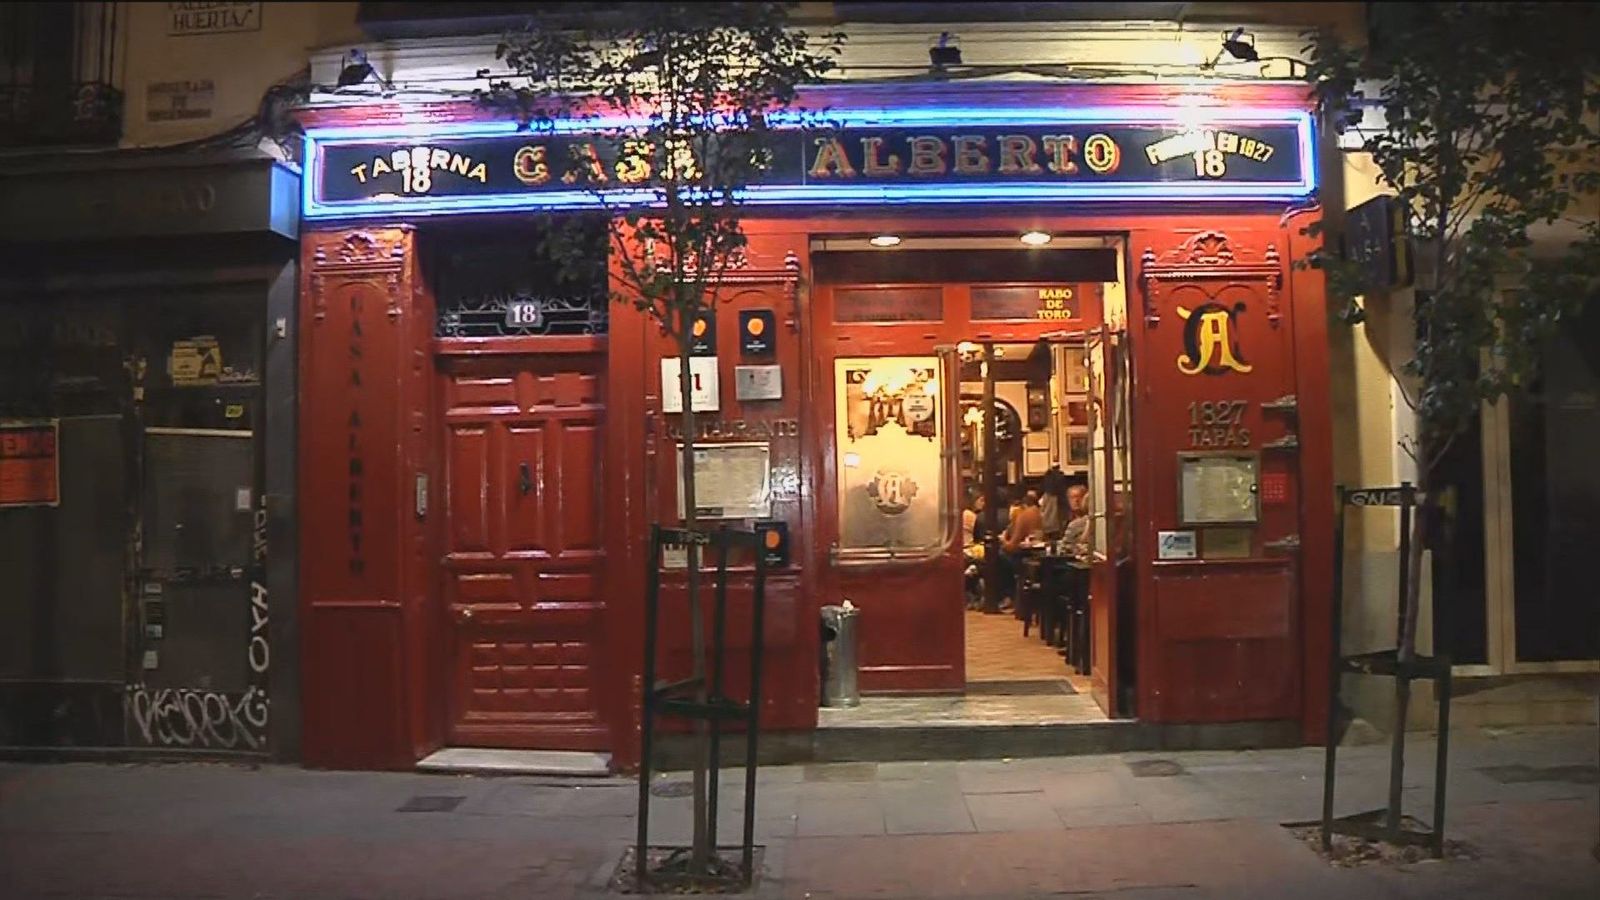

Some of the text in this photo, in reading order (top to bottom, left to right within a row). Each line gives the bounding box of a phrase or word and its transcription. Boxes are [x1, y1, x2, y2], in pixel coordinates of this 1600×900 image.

[809, 133, 1121, 177] ALBERTO
[1240, 138, 1275, 163] 1827
[350, 146, 487, 184] TABERNA
[1192, 149, 1227, 178] 18
[401, 166, 432, 193] 18
[1038, 288, 1073, 300] RABO
[1045, 299, 1064, 309] DE
[512, 304, 536, 324] 18
[1036, 309, 1072, 320] TORO
[1187, 399, 1249, 425] 1827
[1188, 427, 1251, 447] TAPAS
